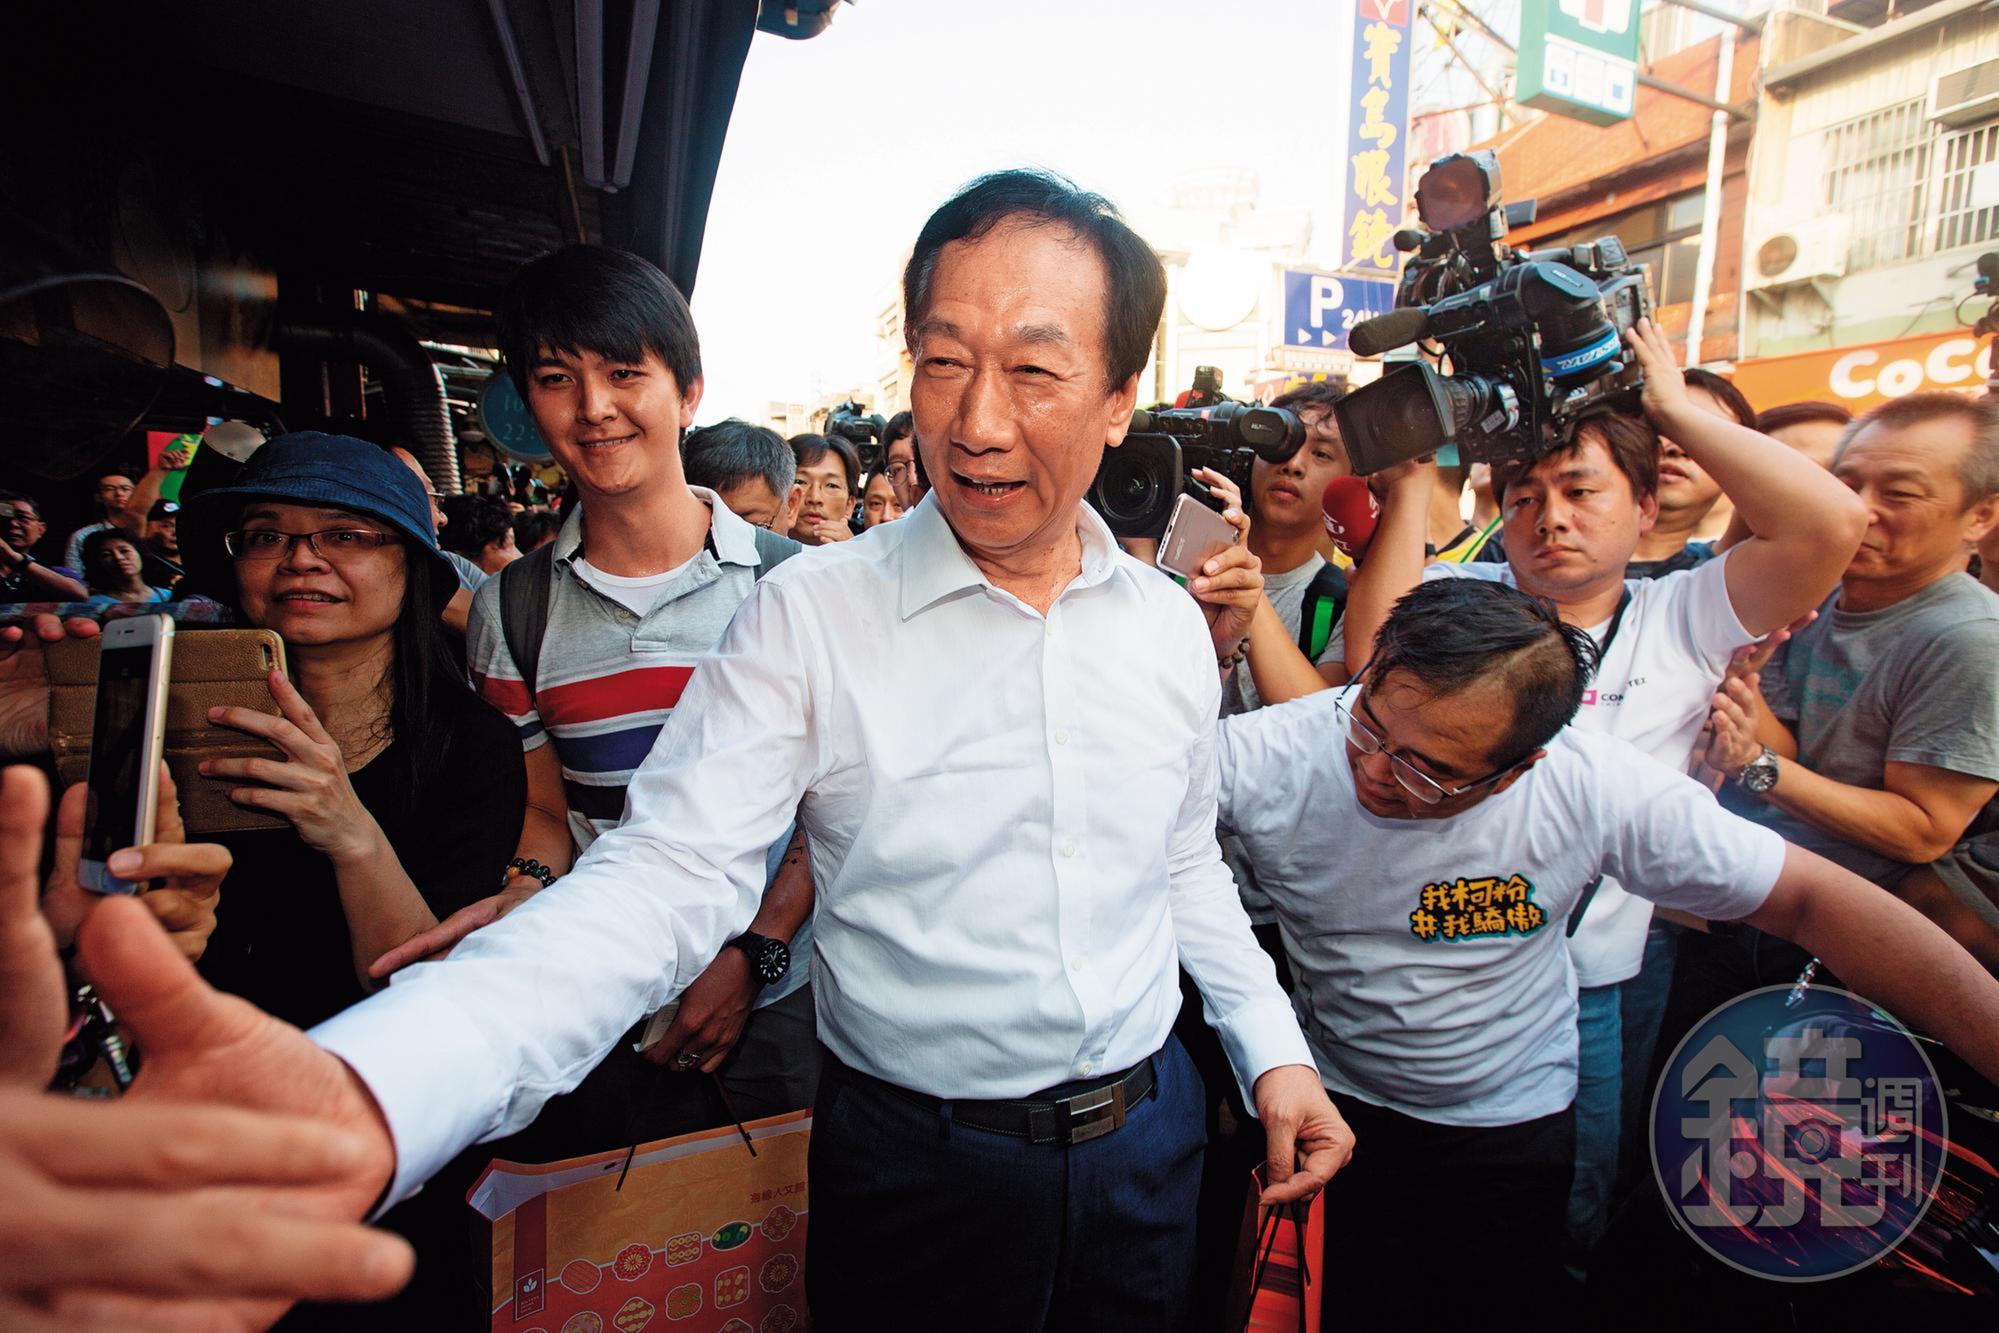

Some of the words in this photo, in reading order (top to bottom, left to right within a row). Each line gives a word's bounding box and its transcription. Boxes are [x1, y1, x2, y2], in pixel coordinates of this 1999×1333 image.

[1310, 275, 1344, 328] P
[1422, 875, 1529, 911] 我柯粉
